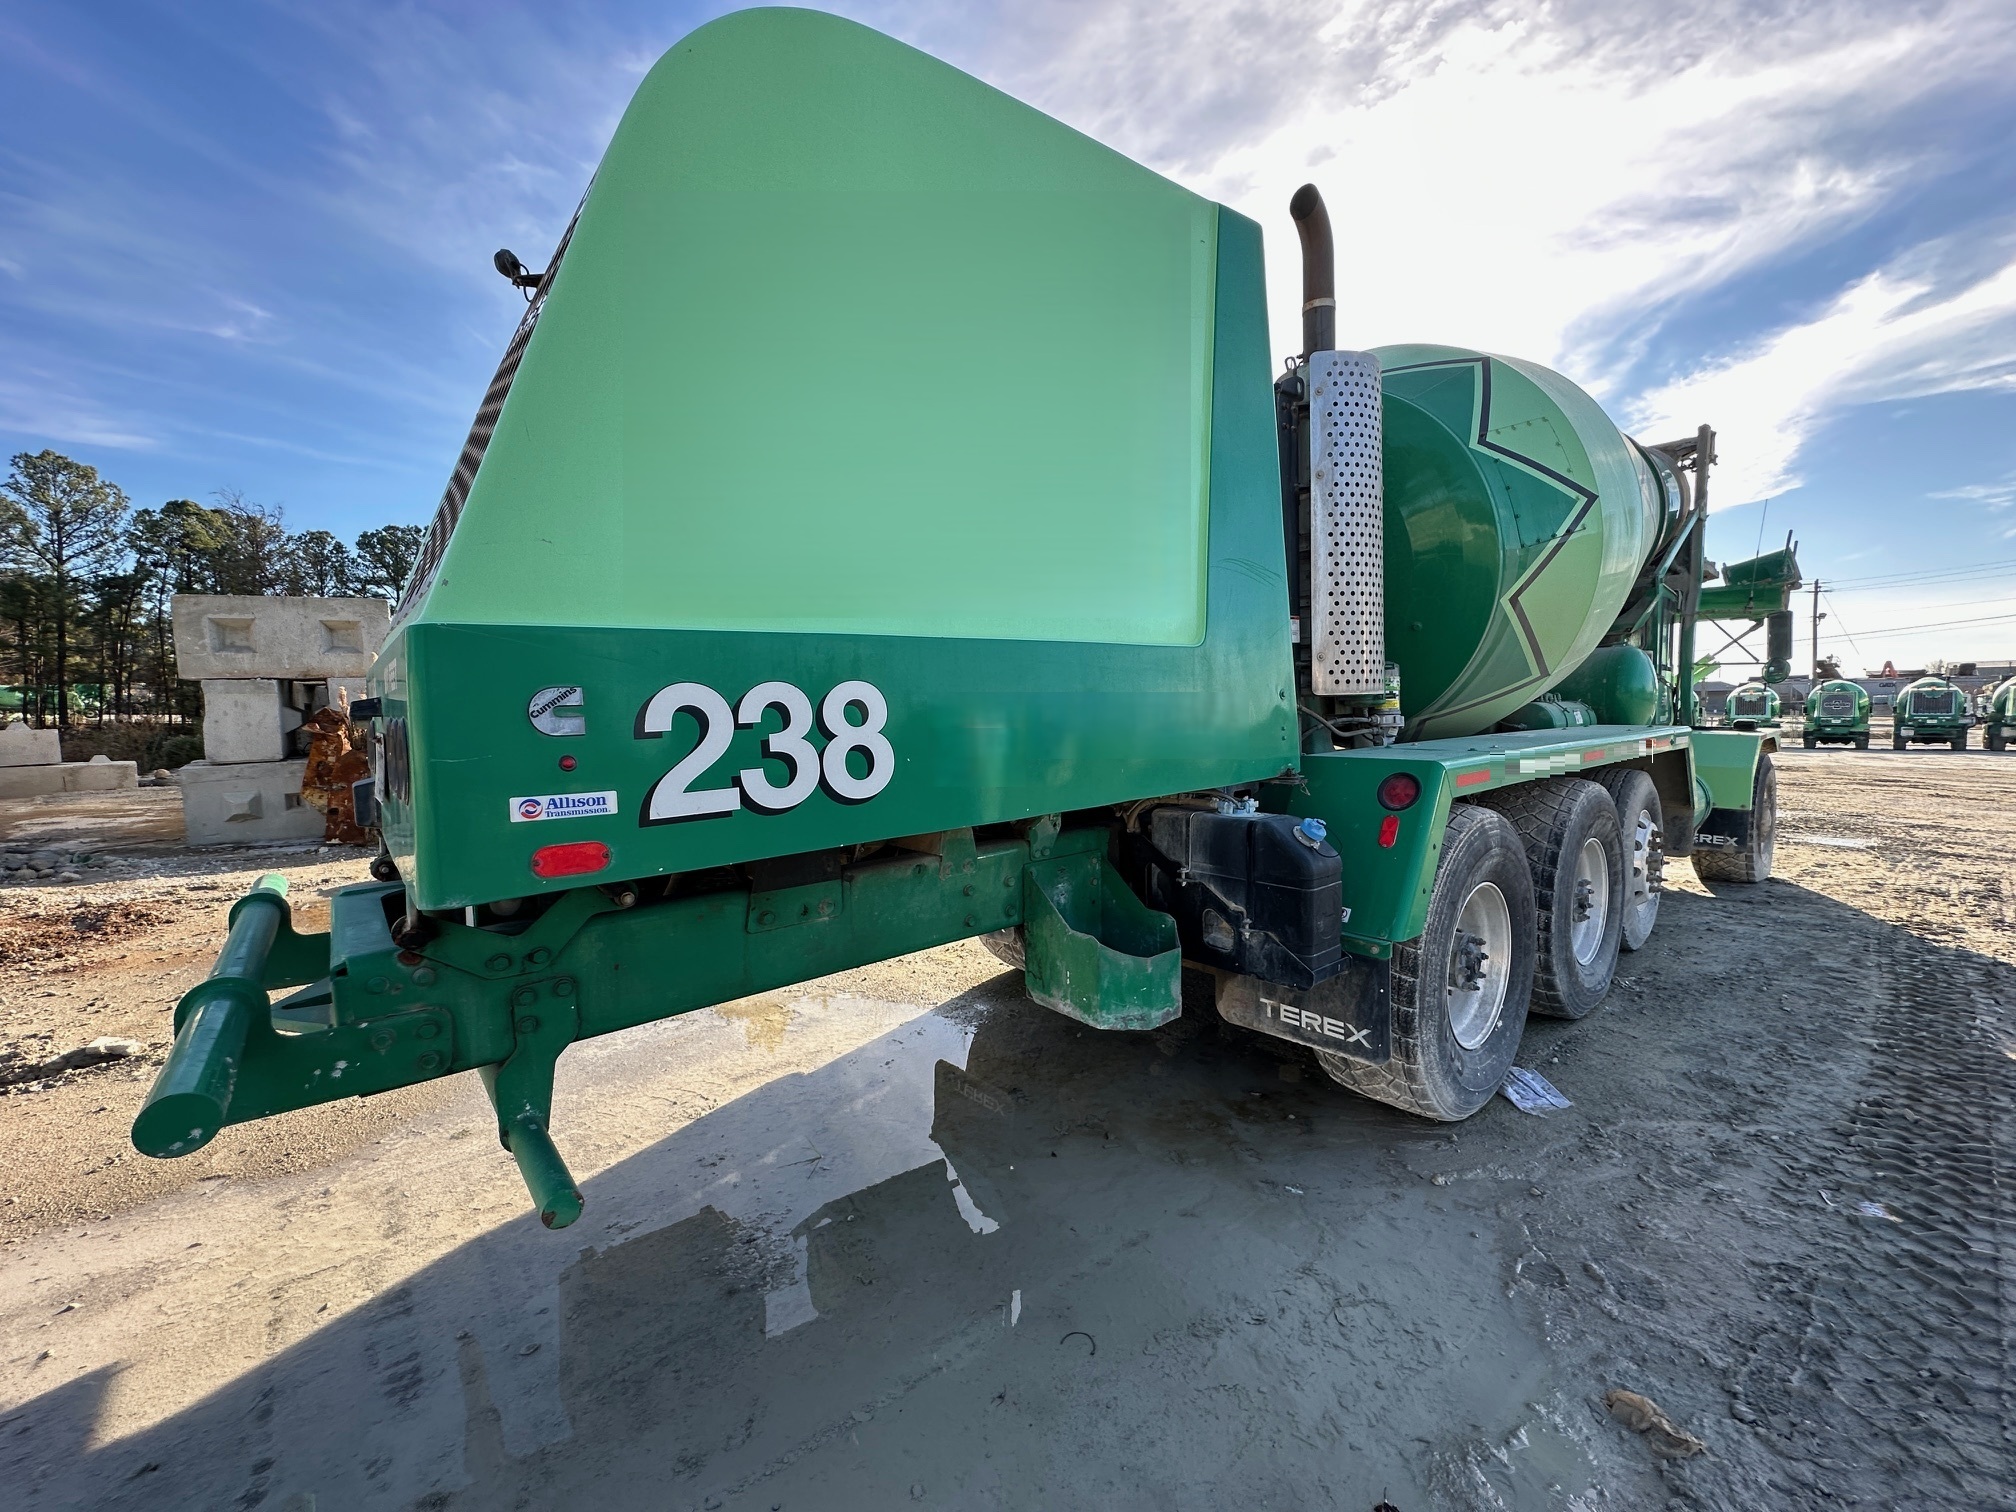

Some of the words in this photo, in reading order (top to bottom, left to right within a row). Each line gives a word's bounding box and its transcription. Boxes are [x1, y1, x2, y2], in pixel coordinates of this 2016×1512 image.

[530, 687, 577, 718] Cummins
[641, 680, 895, 822] 238
[545, 796, 607, 810] Allison
[545, 807, 608, 818] Transmission
[1260, 997, 1373, 1049] TEREX
